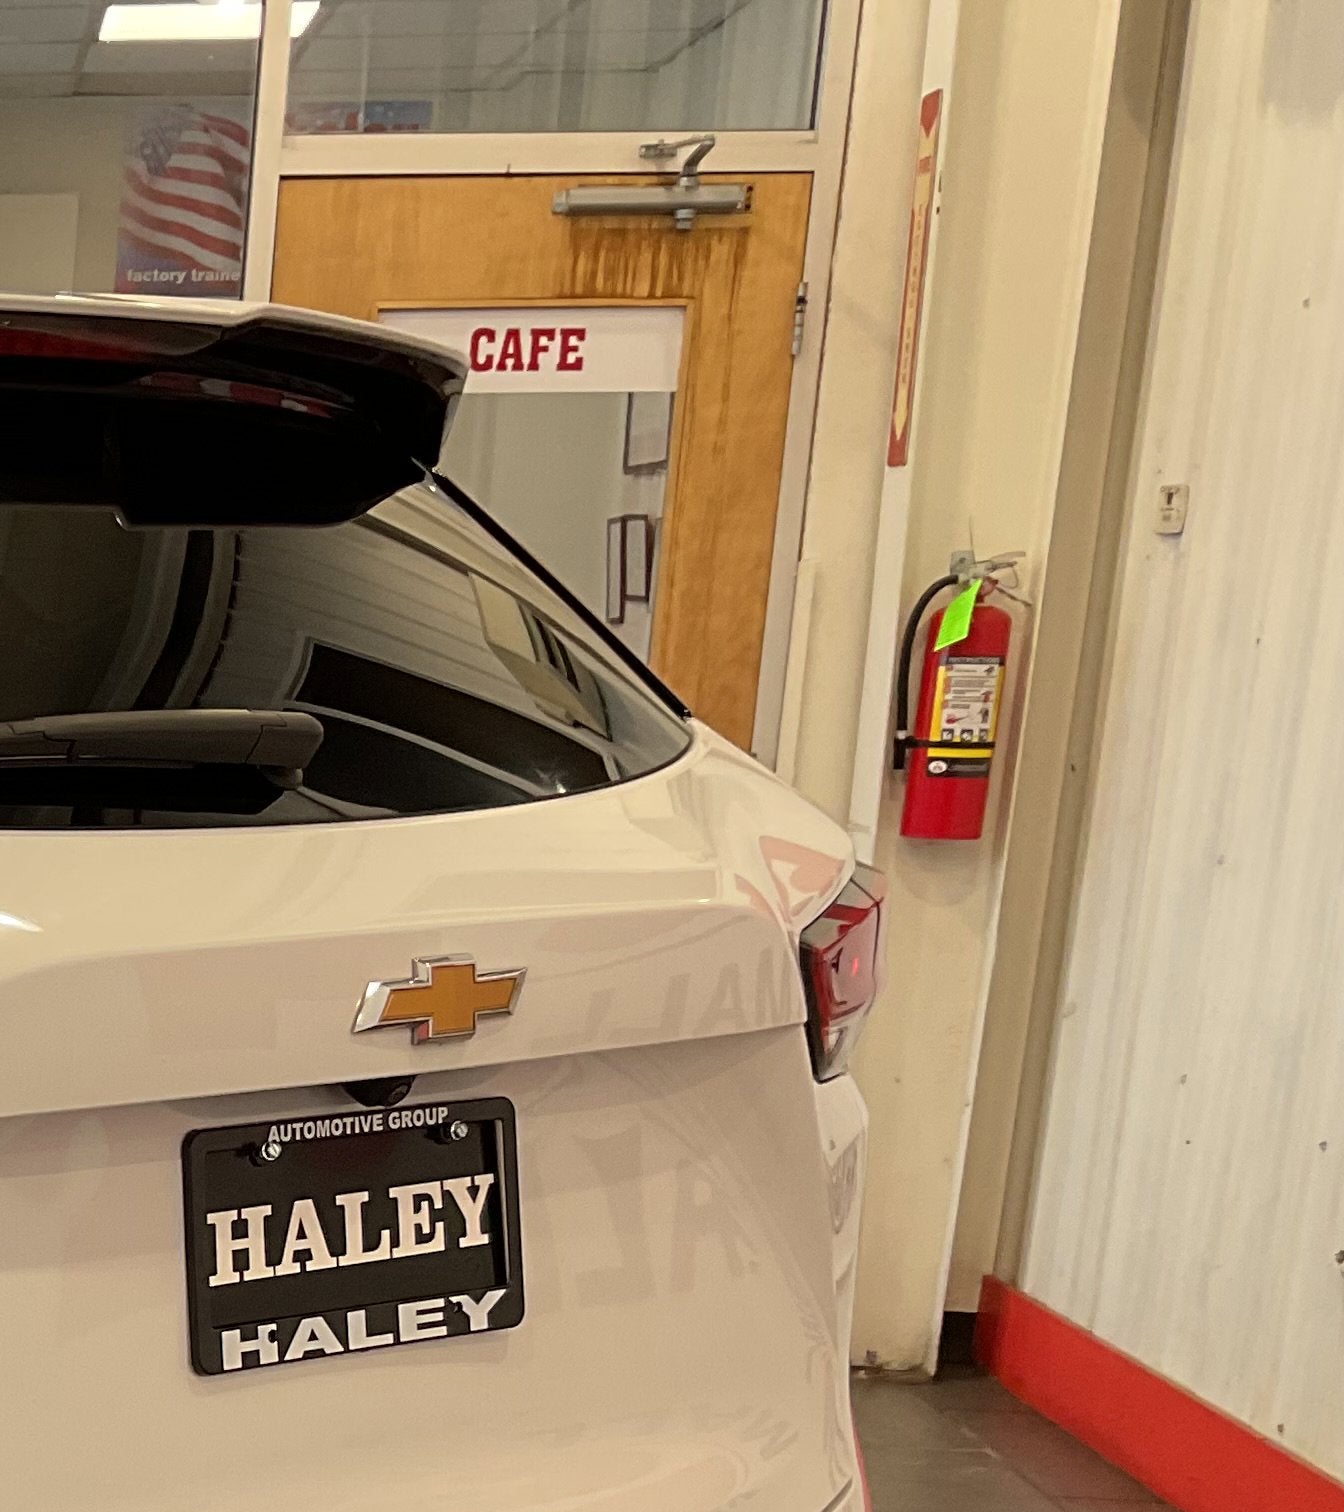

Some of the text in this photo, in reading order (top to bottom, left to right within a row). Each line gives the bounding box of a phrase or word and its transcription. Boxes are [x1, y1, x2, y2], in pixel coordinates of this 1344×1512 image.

[127, 268, 187, 284] factory
[469, 327, 586, 372] CAFE
[267, 1106, 449, 1144] AUTOMOTIVE GROUP
[206, 1172, 494, 1288] HALEY
[220, 1288, 508, 1371] HALEY
